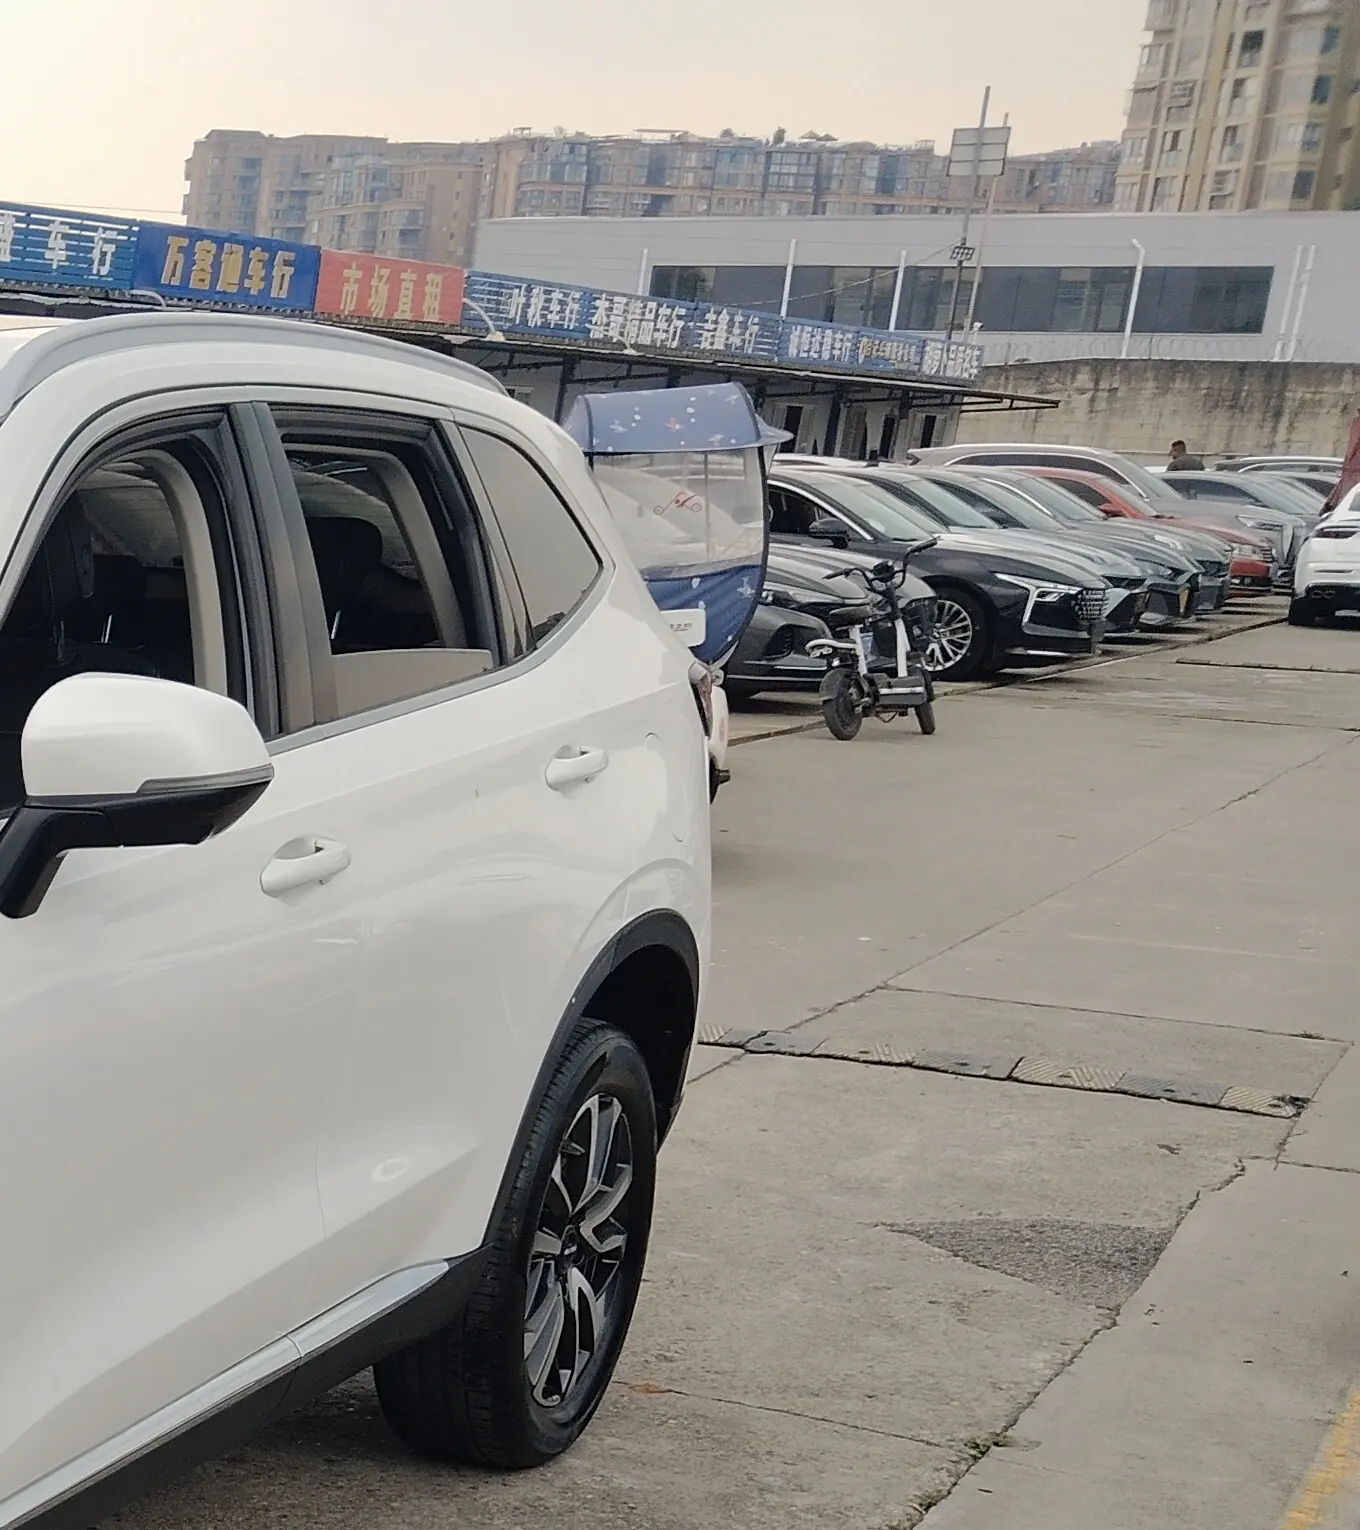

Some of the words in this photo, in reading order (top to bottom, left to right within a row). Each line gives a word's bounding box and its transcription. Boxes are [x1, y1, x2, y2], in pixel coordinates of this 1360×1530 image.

[160, 236, 296, 299] 万客通车行
[340, 262, 443, 321] 市场直租
